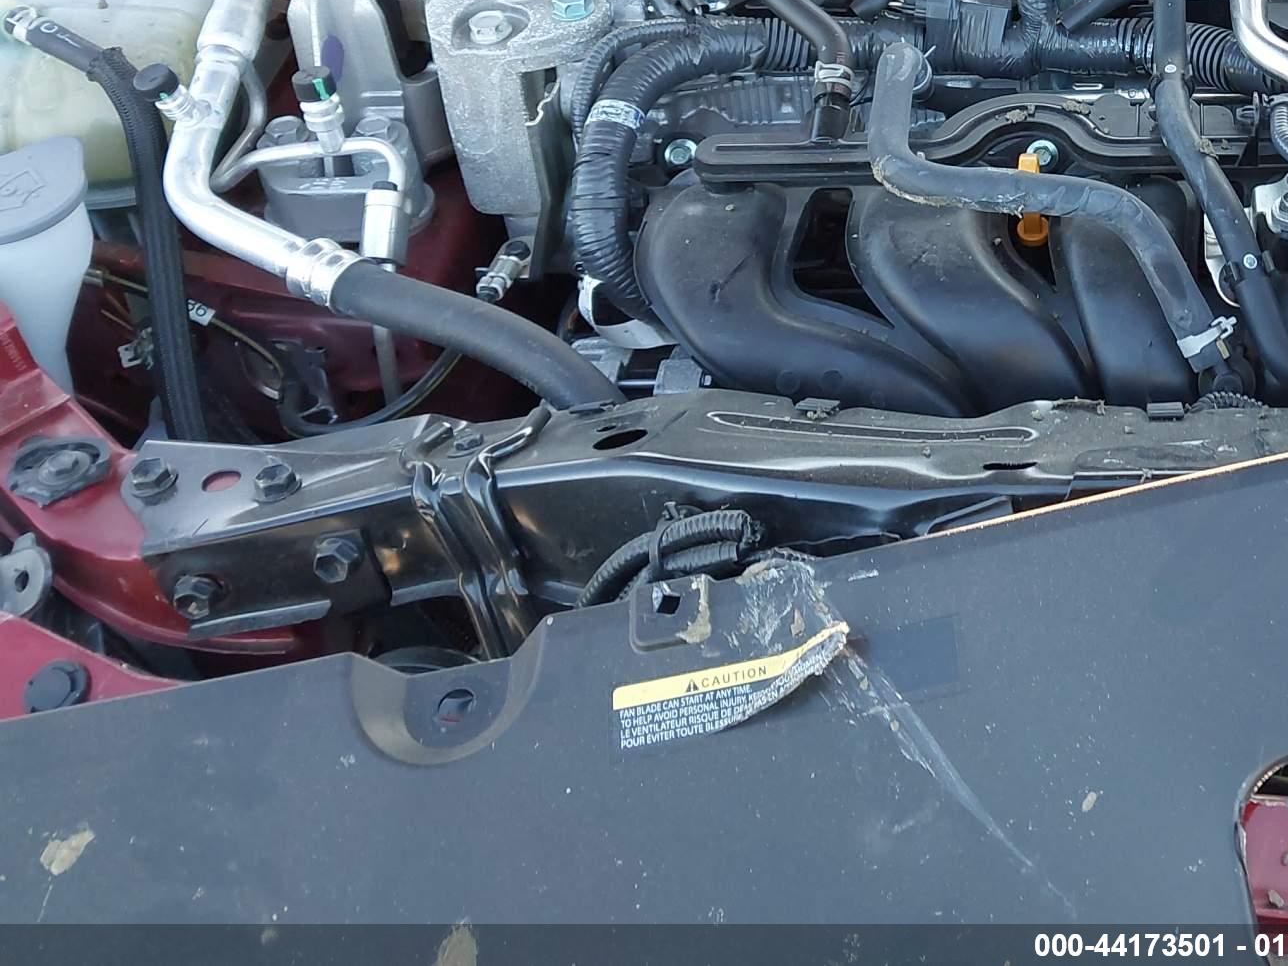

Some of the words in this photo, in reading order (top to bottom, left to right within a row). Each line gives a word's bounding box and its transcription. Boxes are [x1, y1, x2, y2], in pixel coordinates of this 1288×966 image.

[701, 665, 767, 688] CAUTION
[619, 708, 635, 720] FAN
[636, 703, 661, 716] BLADE
[662, 698, 680, 710] CAN
[680, 693, 704, 707] START
[704, 691, 714, 702] AT
[715, 687, 732, 700] ANY
[620, 719, 632, 729] TO
[633, 714, 652, 727] HELP
[653, 709, 678, 722] AVOID
[679, 700, 719, 718] PERSONAL
[620, 729, 631, 740] LE
[631, 718, 688, 737] VENTILATEUR
[688, 710, 719, 725] RISQUE
[720, 708, 733, 719] DE
[620, 737, 646, 750] POUR
[676, 723, 704, 739] TOUTE
